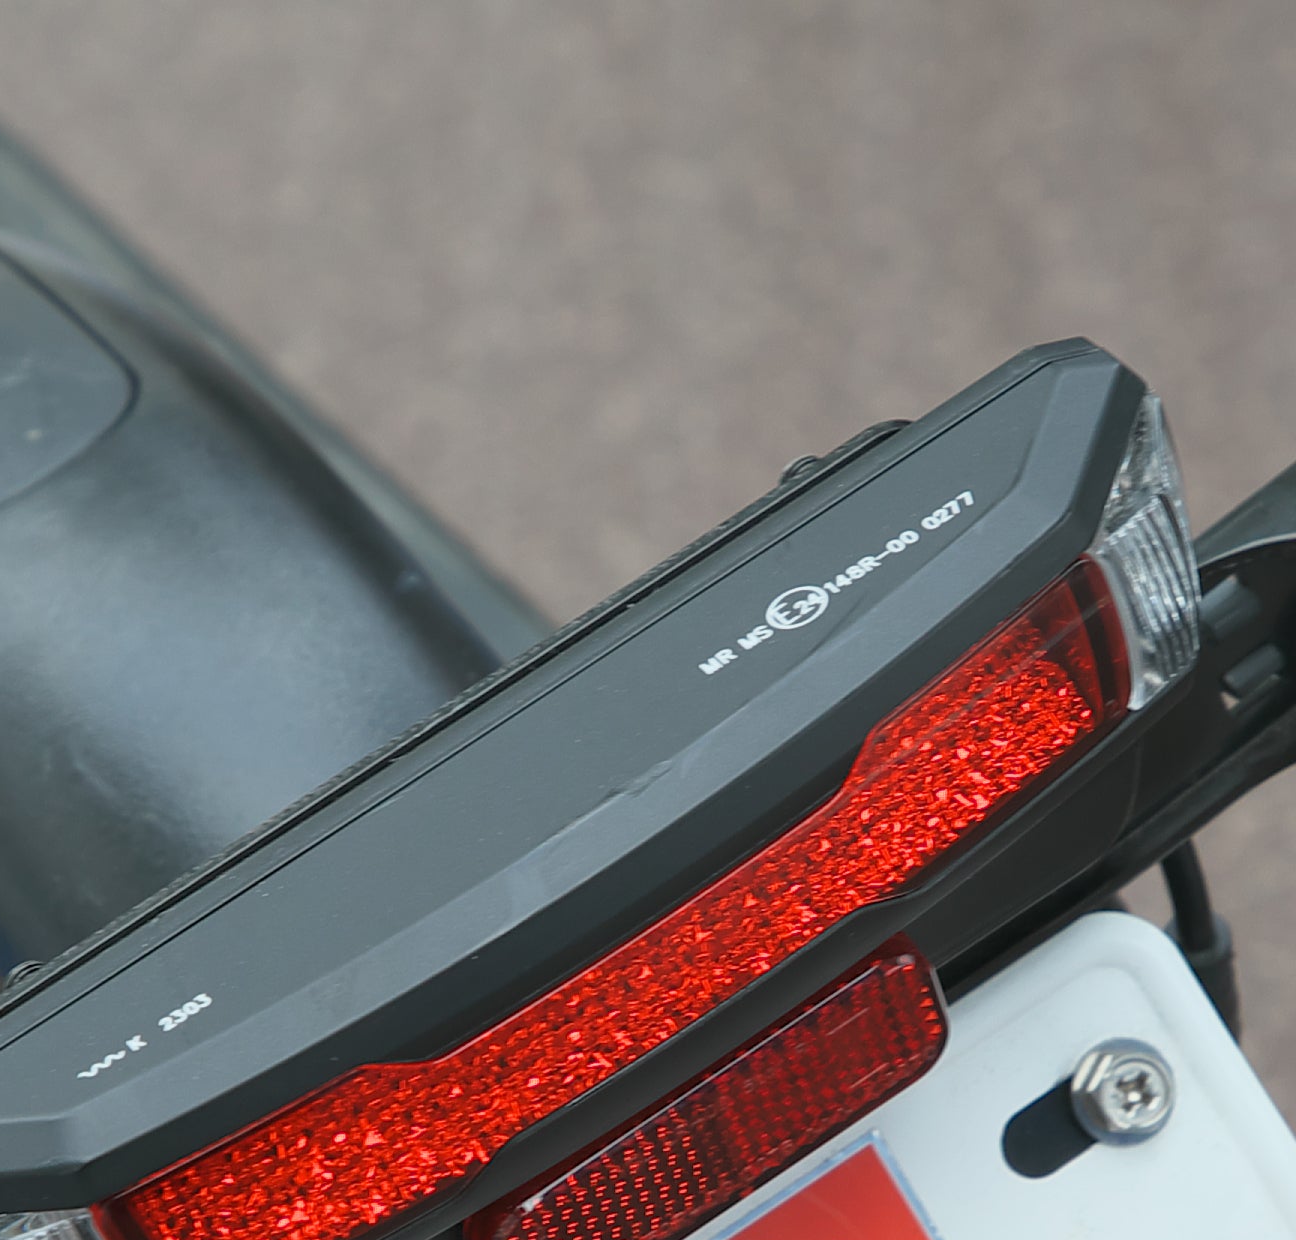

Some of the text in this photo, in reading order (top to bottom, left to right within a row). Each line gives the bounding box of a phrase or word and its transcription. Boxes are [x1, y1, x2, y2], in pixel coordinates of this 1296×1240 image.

[698, 648, 739, 675] MR
[737, 625, 774, 650] MS
[921, 491, 974, 530] 0277
[158, 993, 213, 1032] 2303
